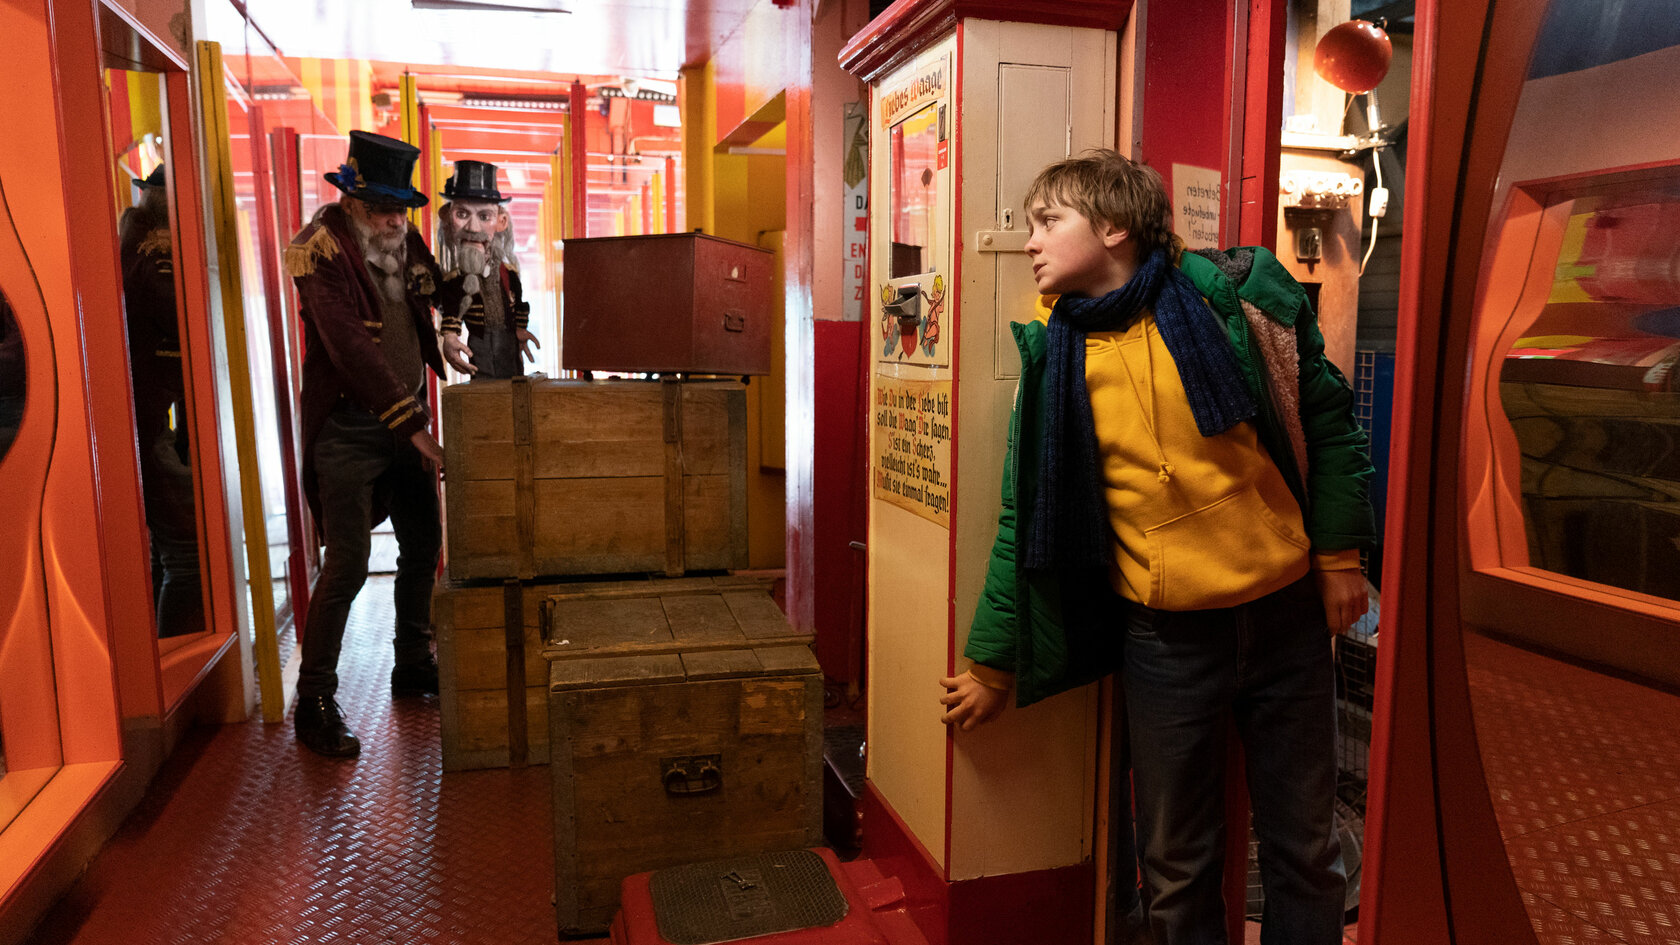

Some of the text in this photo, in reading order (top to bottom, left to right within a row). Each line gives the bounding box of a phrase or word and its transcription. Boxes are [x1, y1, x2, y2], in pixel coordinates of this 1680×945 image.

[877, 387, 888, 406] Wie
[889, 388, 897, 407] Du
[898, 386, 904, 408] in
[905, 390, 916, 411] der
[917, 390, 935, 415] Liebe
[889, 410, 897, 429] die
[901, 433, 911, 454] ein
[881, 449, 906, 475] vielleicht
[892, 474, 901, 494] sie
[902, 477, 924, 503] einmal
[924, 485, 949, 514] fragen!
